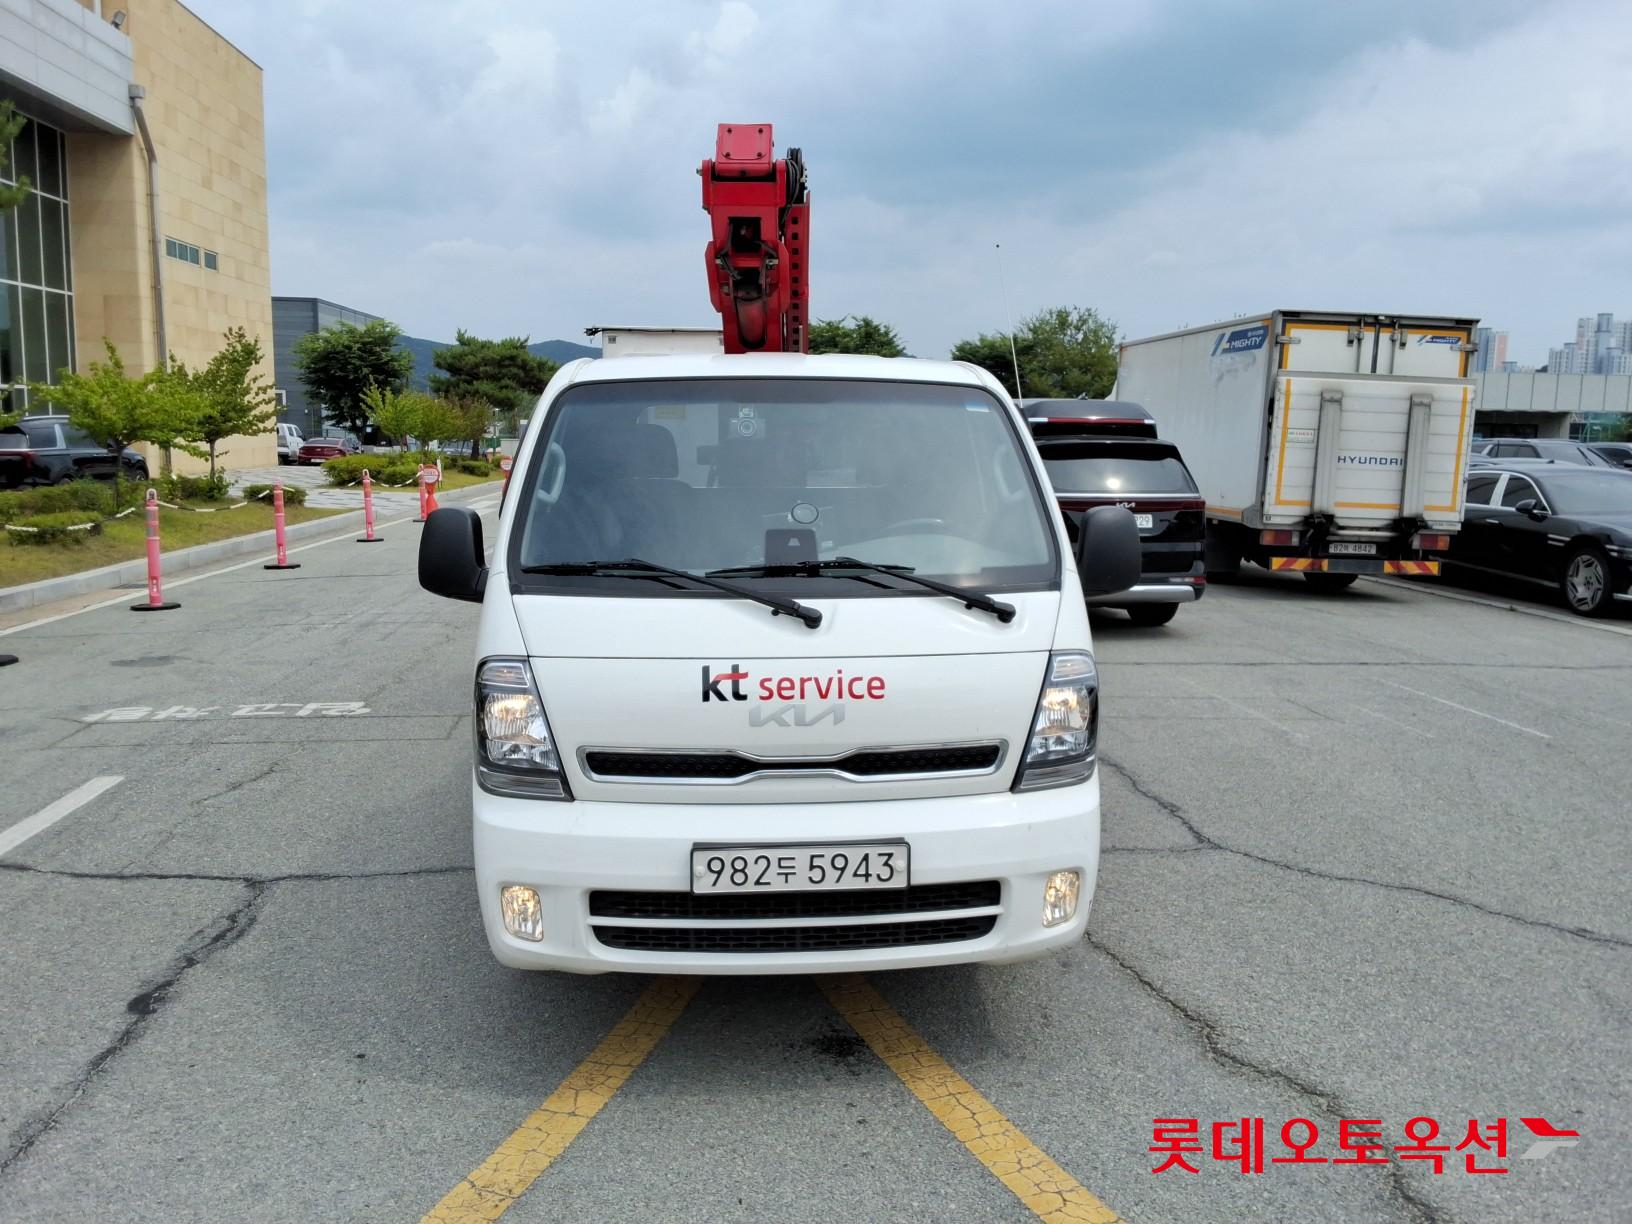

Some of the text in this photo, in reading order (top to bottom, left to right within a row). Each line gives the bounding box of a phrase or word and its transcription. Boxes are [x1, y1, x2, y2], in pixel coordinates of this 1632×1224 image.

[1231, 336, 1262, 349] MIGHTY
[1337, 455, 1403, 466] HYUNDAI
[701, 664, 886, 703] kt service
[749, 703, 846, 728] KIA
[706, 852, 895, 887] 982두 5943
